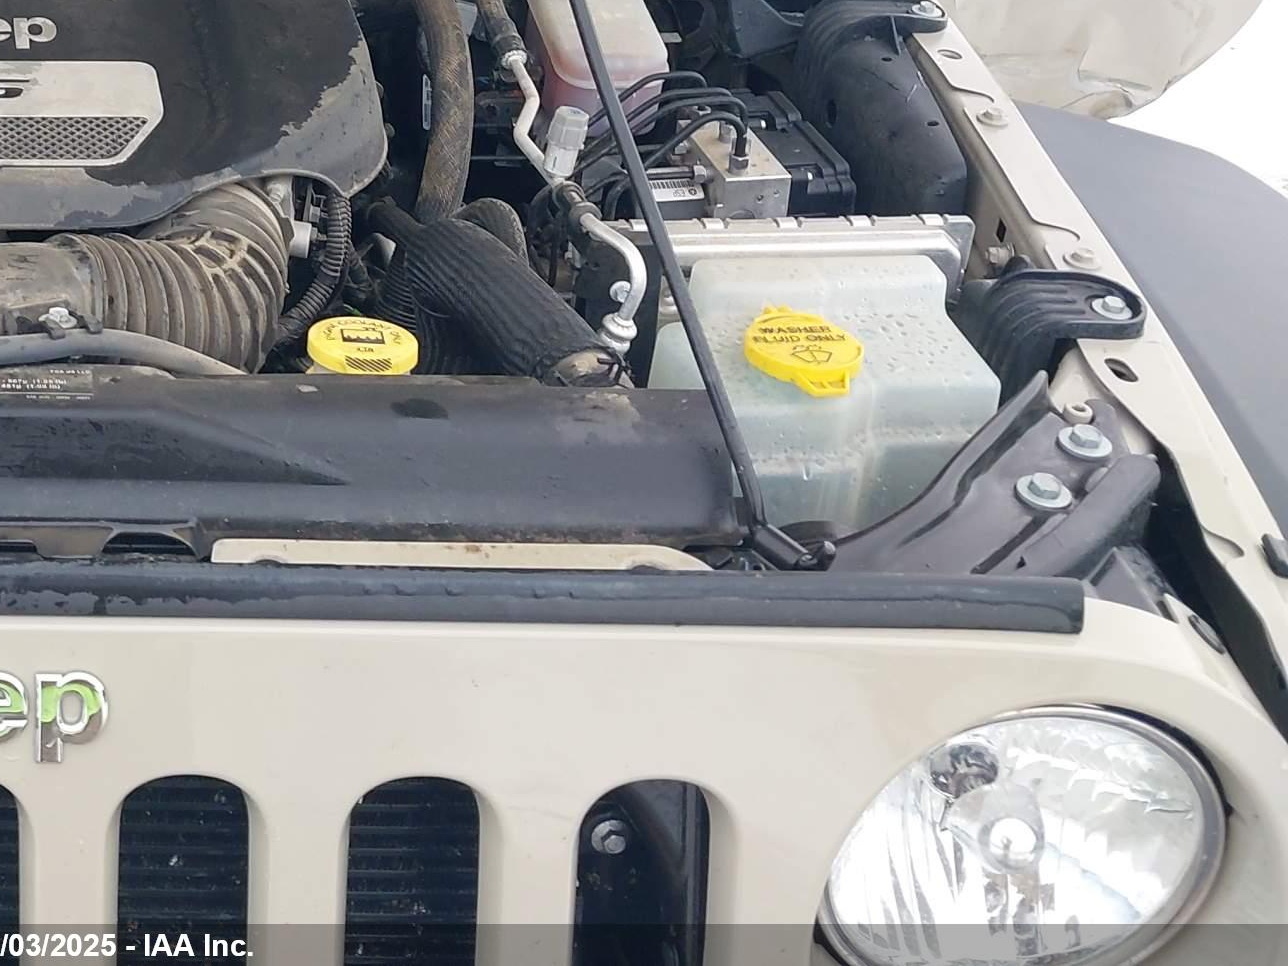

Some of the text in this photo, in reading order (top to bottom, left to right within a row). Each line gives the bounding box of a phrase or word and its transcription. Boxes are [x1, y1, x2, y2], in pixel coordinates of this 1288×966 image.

[759, 325, 832, 334] WASHER
[752, 333, 846, 343] FLUID ONLY
